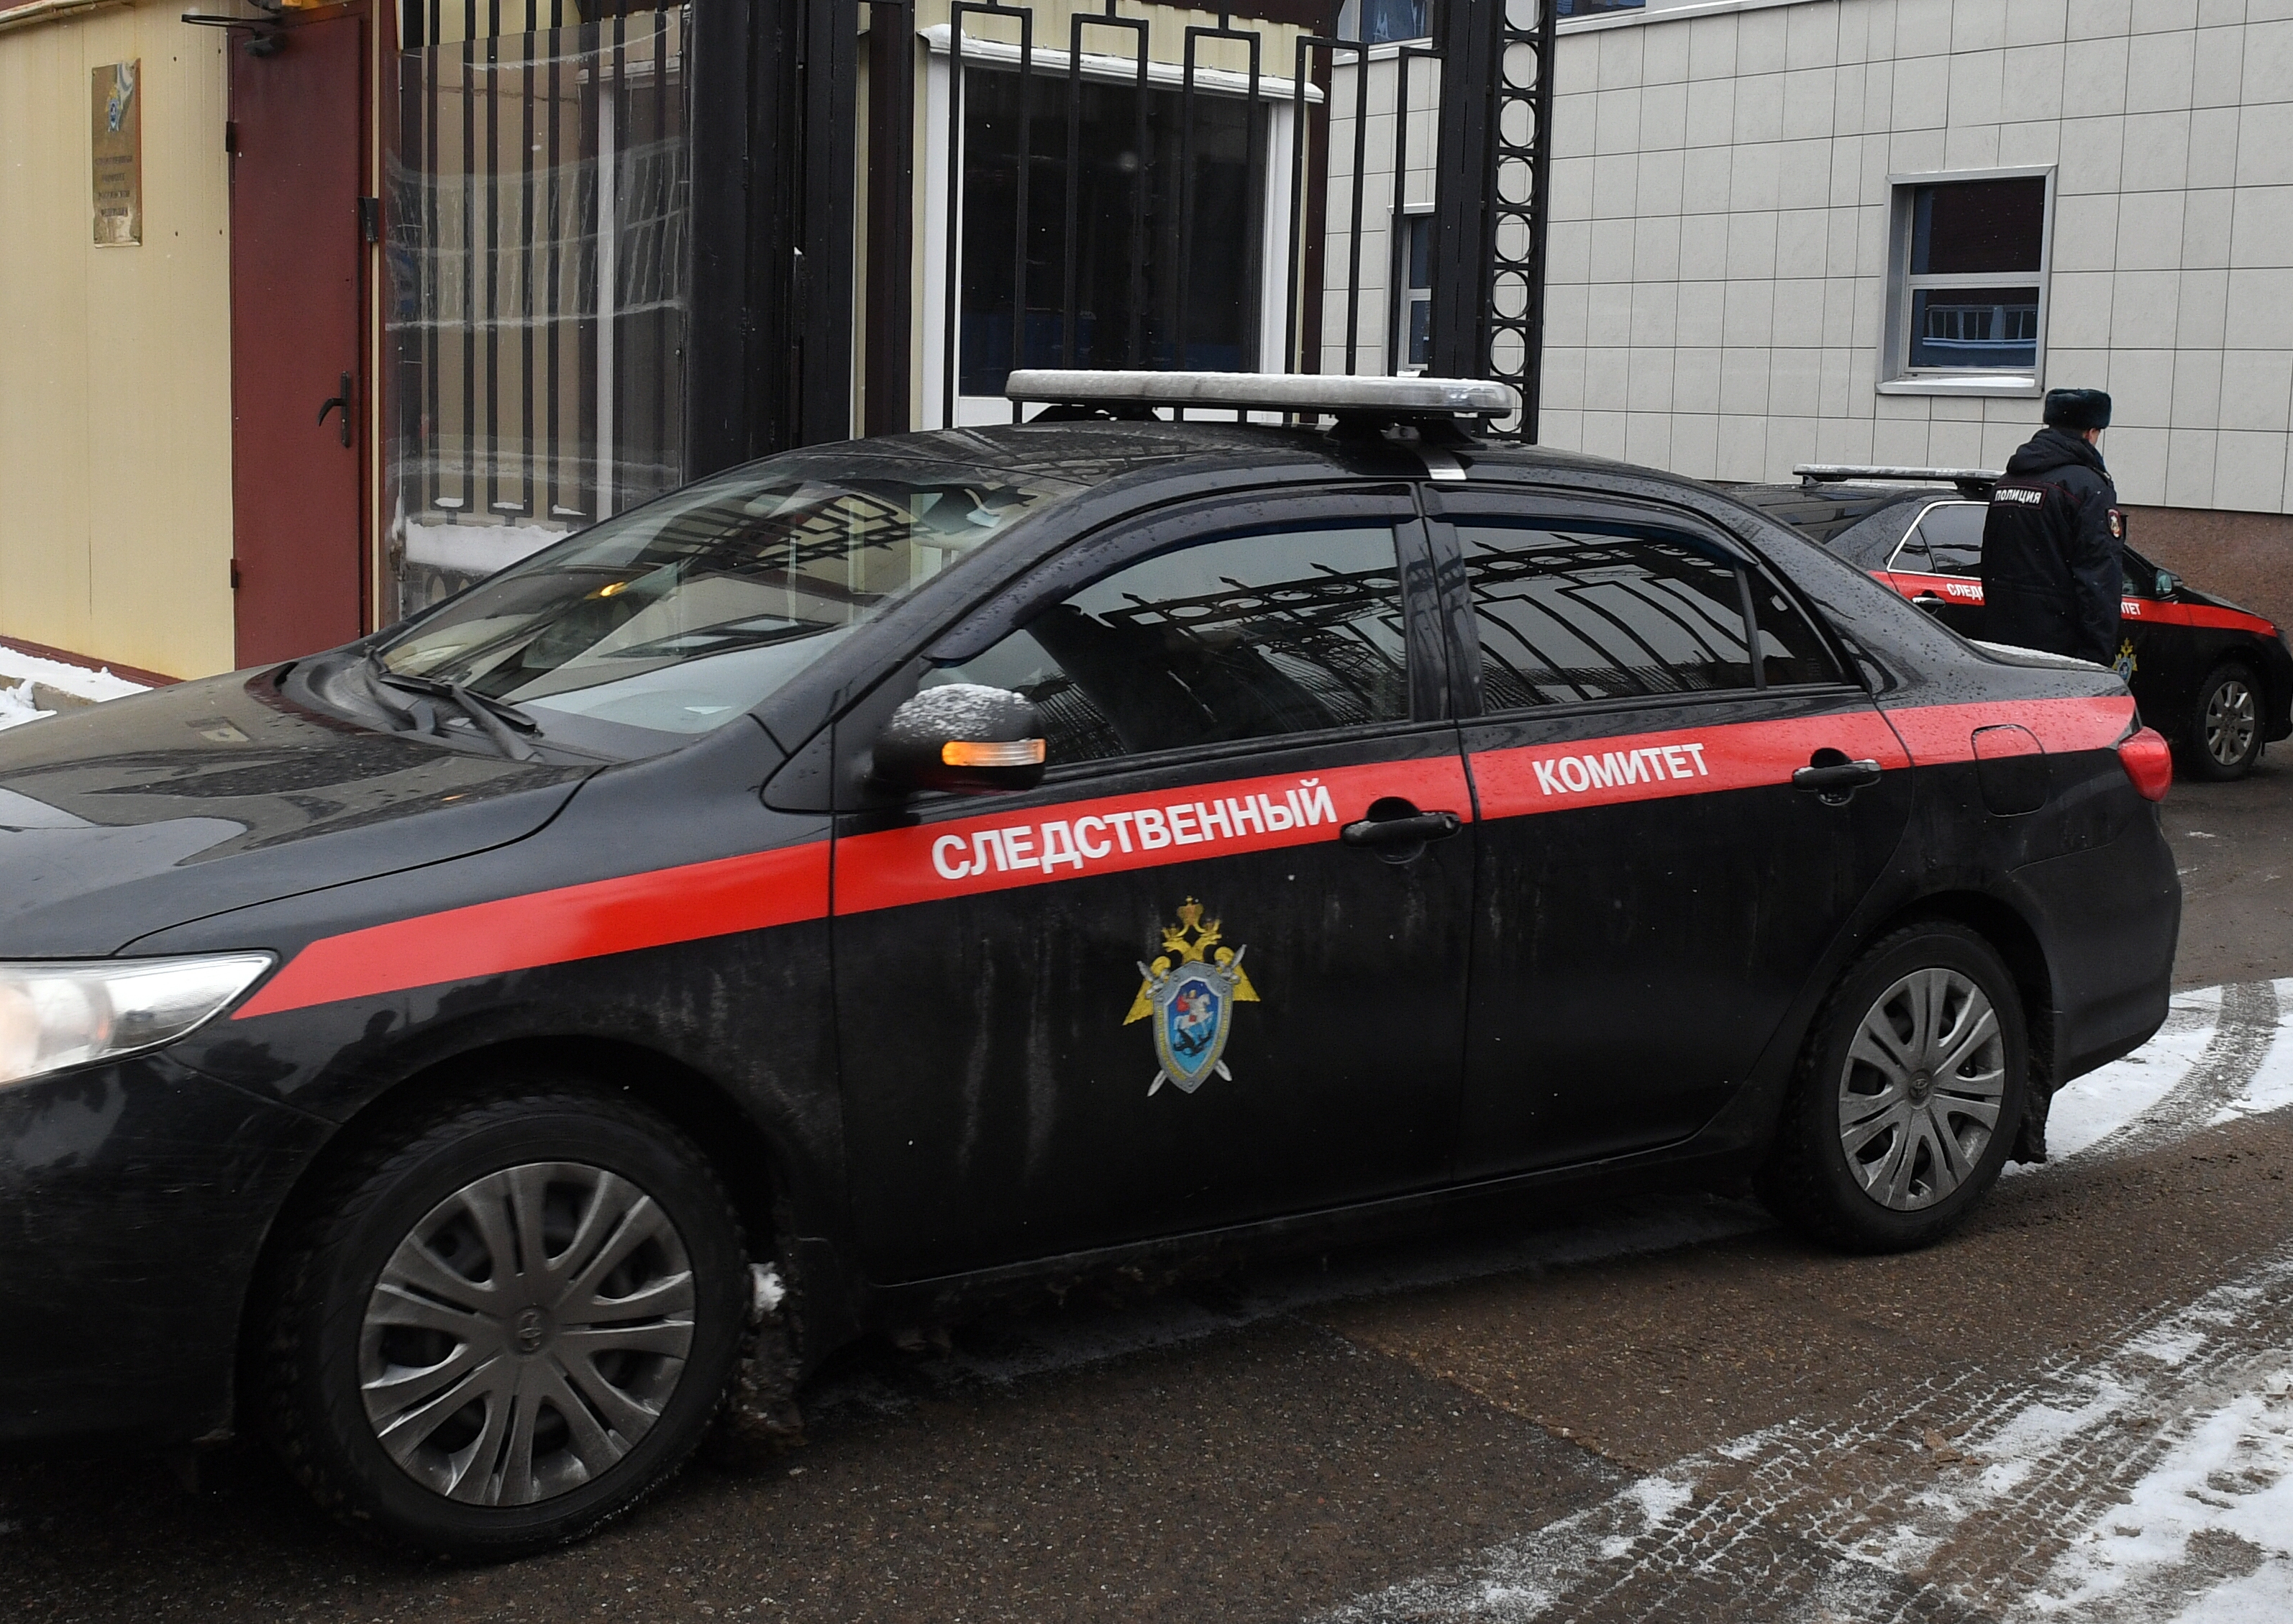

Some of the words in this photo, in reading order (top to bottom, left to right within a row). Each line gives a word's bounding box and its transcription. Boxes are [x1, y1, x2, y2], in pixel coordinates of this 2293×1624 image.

[1995, 489, 2042, 504] ПОЛИЦИЯ
[931, 778, 1337, 879] СЛЕДСТВЕННЫЙ
[1531, 743, 1708, 795] КОМИТЕТ
